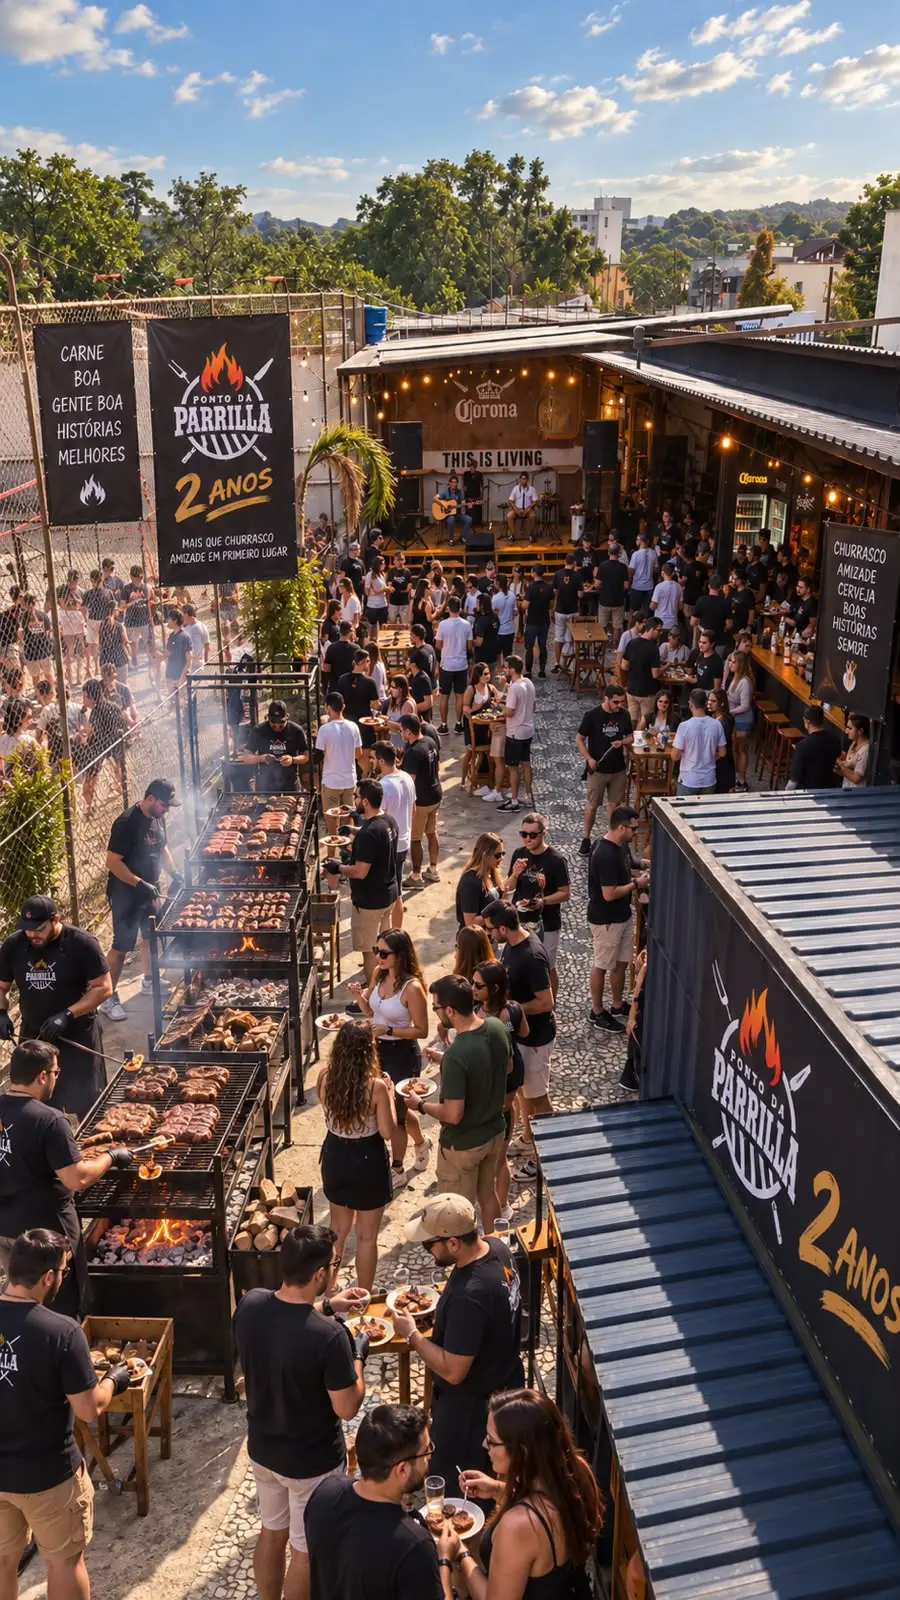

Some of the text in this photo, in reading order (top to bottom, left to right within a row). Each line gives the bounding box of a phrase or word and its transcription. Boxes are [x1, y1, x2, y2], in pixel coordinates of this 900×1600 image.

[61, 344, 104, 362] CARNE
[74, 370, 101, 386] BOA
[52, 394, 123, 413] GENTE BOA
[193, 394, 252, 404] PONTO DA
[173, 403, 273, 437] PARRILLA
[455, 399, 518, 424] Corona
[57, 418, 122, 440] HISTÓRIAS
[58, 446, 125, 466] MELHORES
[442, 450, 543, 468] THIS IS LIVING
[174, 467, 273, 523] 2 ANOS
[182, 532, 274, 549] MAIS QUE CHURRASCO
[170, 546, 288, 564] AMIZADE EM PRIMEIRO LUGAR
[833, 540, 887, 564] CHURRASCO
[836, 562, 877, 584] AMIZADE
[837, 582, 875, 604] CERVEJA
[843, 601, 867, 620] BOAS
[730, 1049, 785, 1120] PONTO DA
[711, 1047, 799, 1206] PARRILLA
[799, 1170, 900, 1334] 2 ANOS
